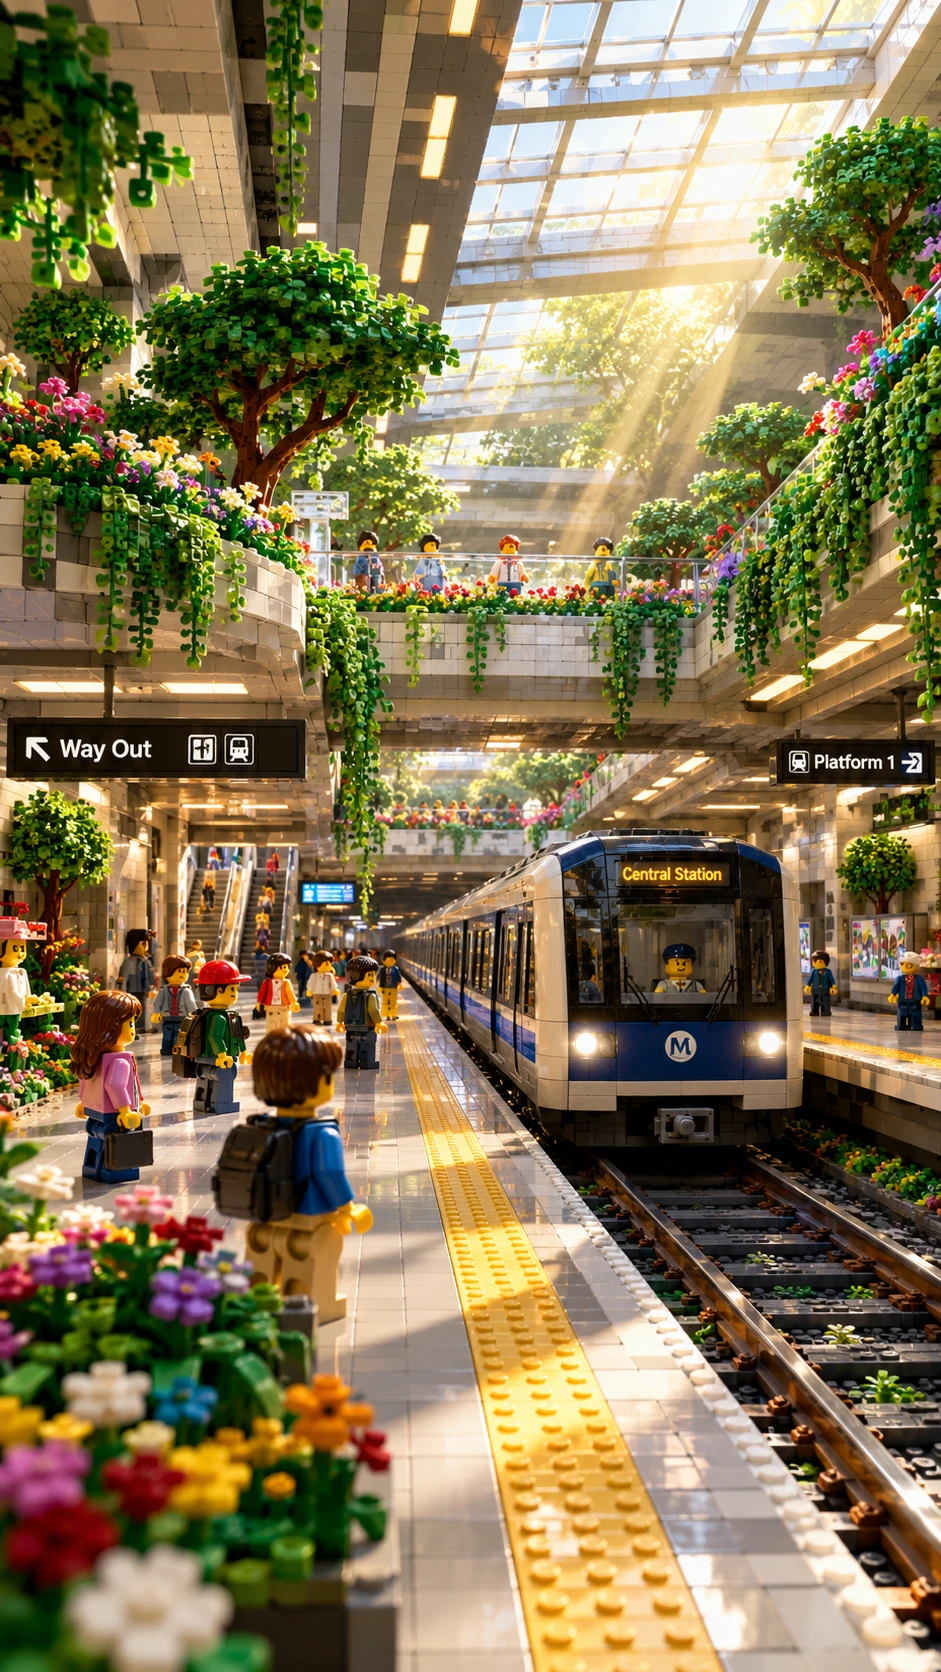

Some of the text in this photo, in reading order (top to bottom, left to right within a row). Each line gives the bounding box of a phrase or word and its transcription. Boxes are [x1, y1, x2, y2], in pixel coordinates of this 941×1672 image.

[60, 739, 152, 762] Way Out
[814, 754, 895, 769] Platform 1
[622, 867, 722, 881] Central Station
[670, 1037, 692, 1056] M
